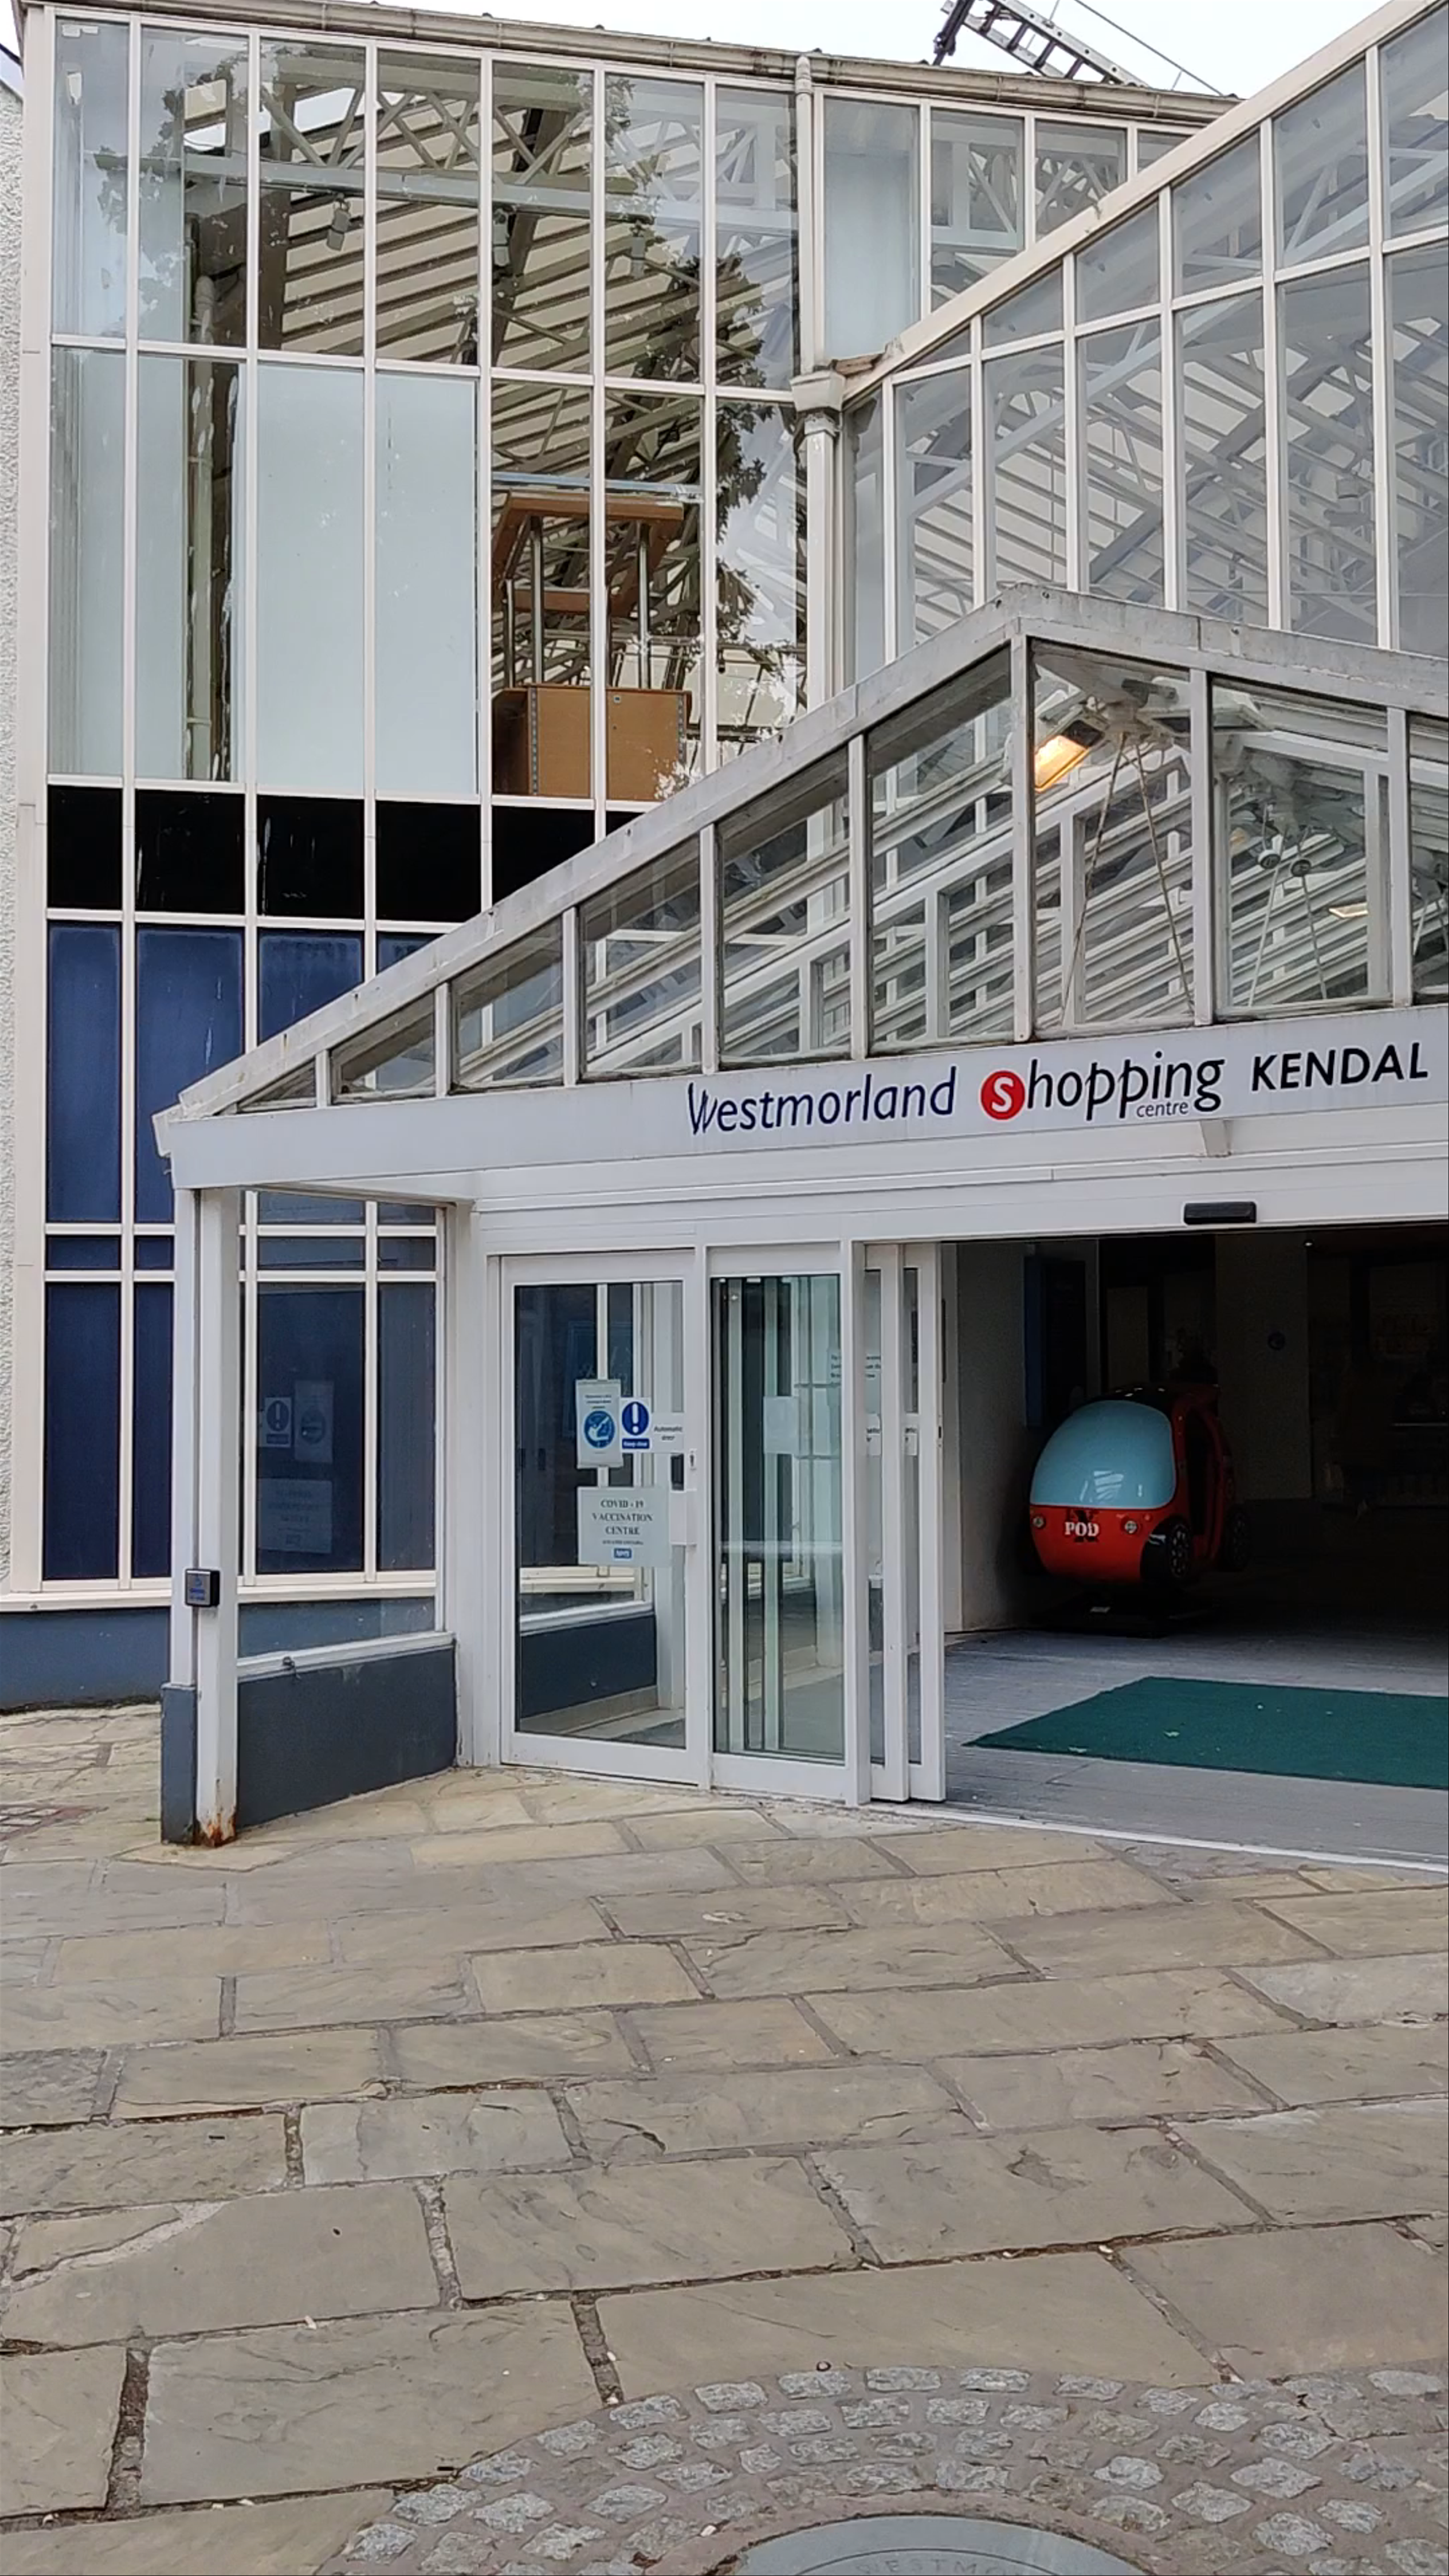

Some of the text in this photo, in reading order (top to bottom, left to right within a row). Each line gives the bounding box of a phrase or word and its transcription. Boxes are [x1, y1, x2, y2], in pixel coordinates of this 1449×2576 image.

[688, 1066, 957, 1135] Westmorland
[1252, 1042, 1428, 1091] KENDAL
[1137, 1100, 1188, 1117] centre
[600, 1500, 628, 1508] COVID
[592, 1512, 653, 1522] VACCINATION
[605, 1526, 640, 1535] CENTRE
[1064, 1522, 1100, 1536] POD
